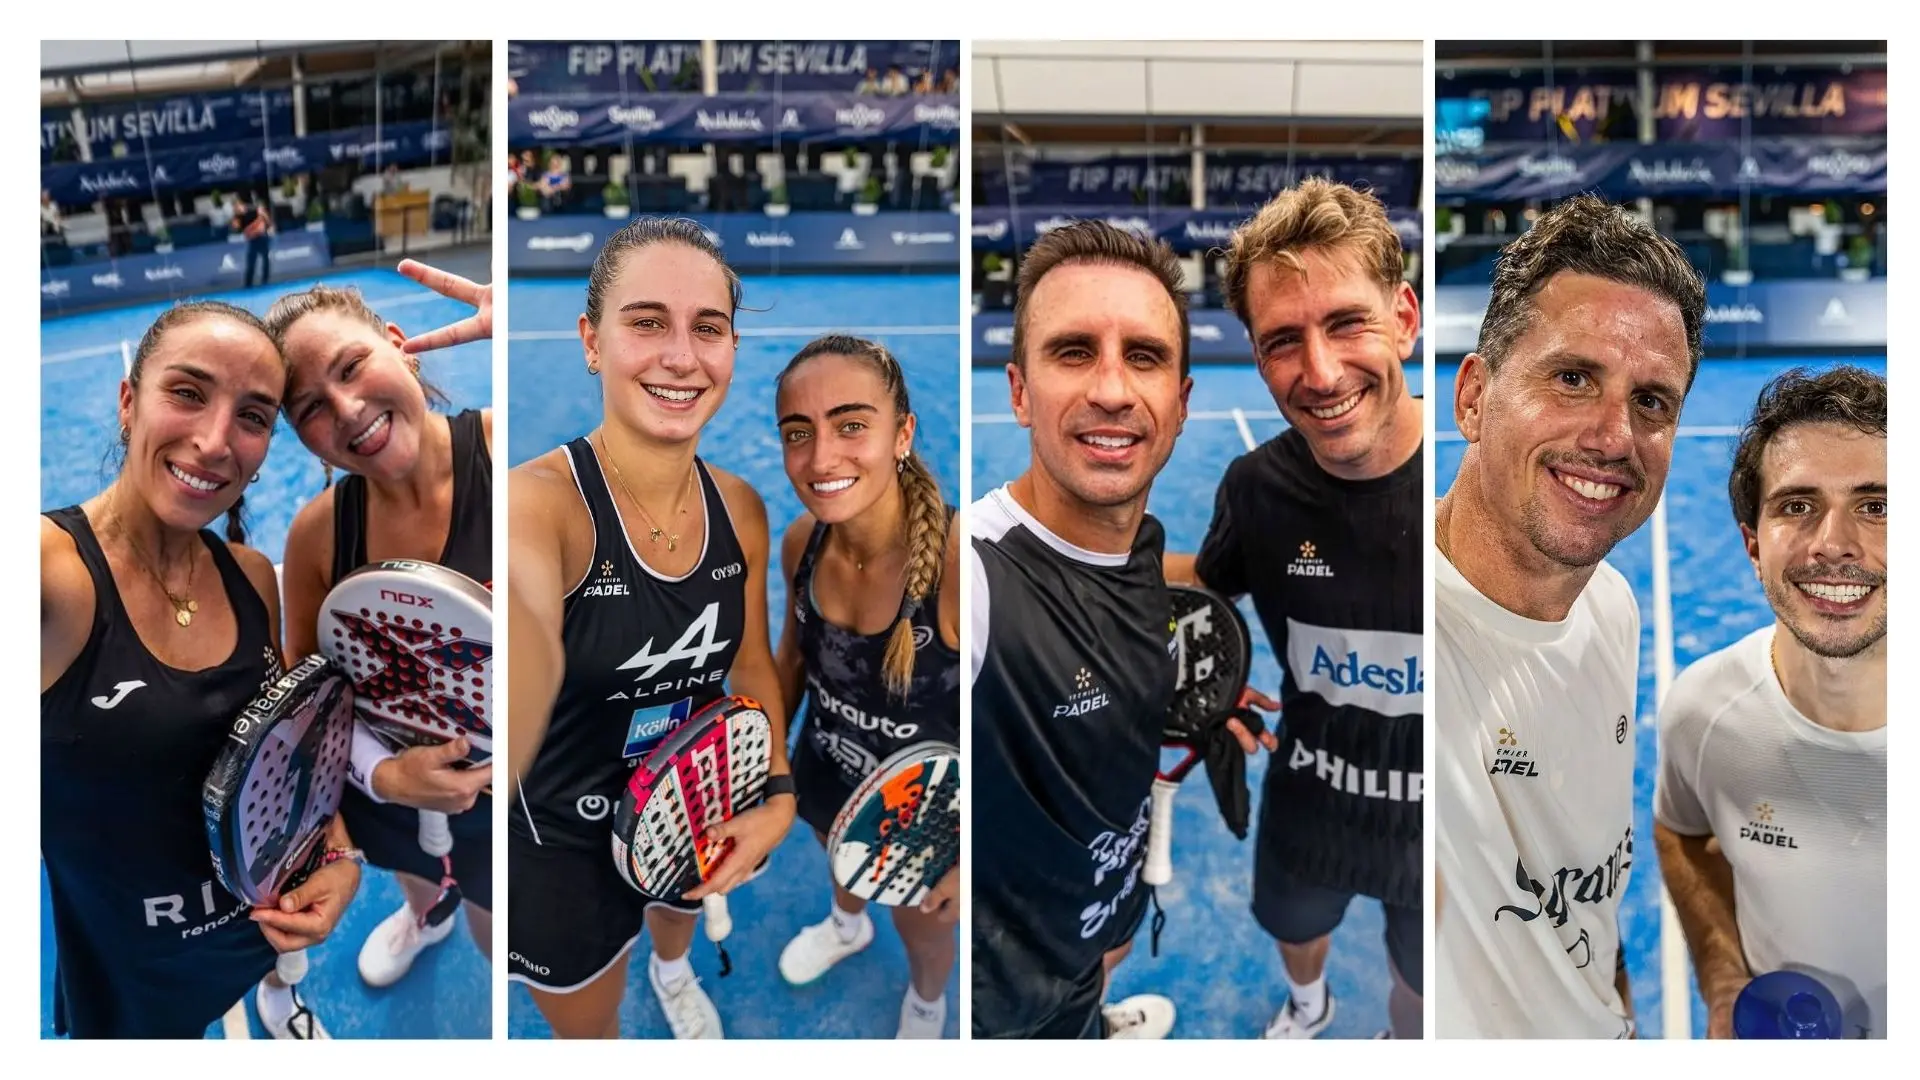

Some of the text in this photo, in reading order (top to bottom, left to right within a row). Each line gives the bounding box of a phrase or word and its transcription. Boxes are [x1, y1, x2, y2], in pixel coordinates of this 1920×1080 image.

[567, 44, 613, 76] FIP
[757, 43, 868, 74] SEVILLA
[1704, 82, 1846, 120] SEVILLA
[122, 104, 217, 141] SEVILLA
[1287, 563, 1335, 578] PADEL
[583, 584, 630, 598] PADEL
[605, 668, 724, 701] ALPINE
[1052, 692, 1110, 719] PADEL
[634, 716, 681, 740] Kölln
[1740, 827, 1799, 849] PADEL
